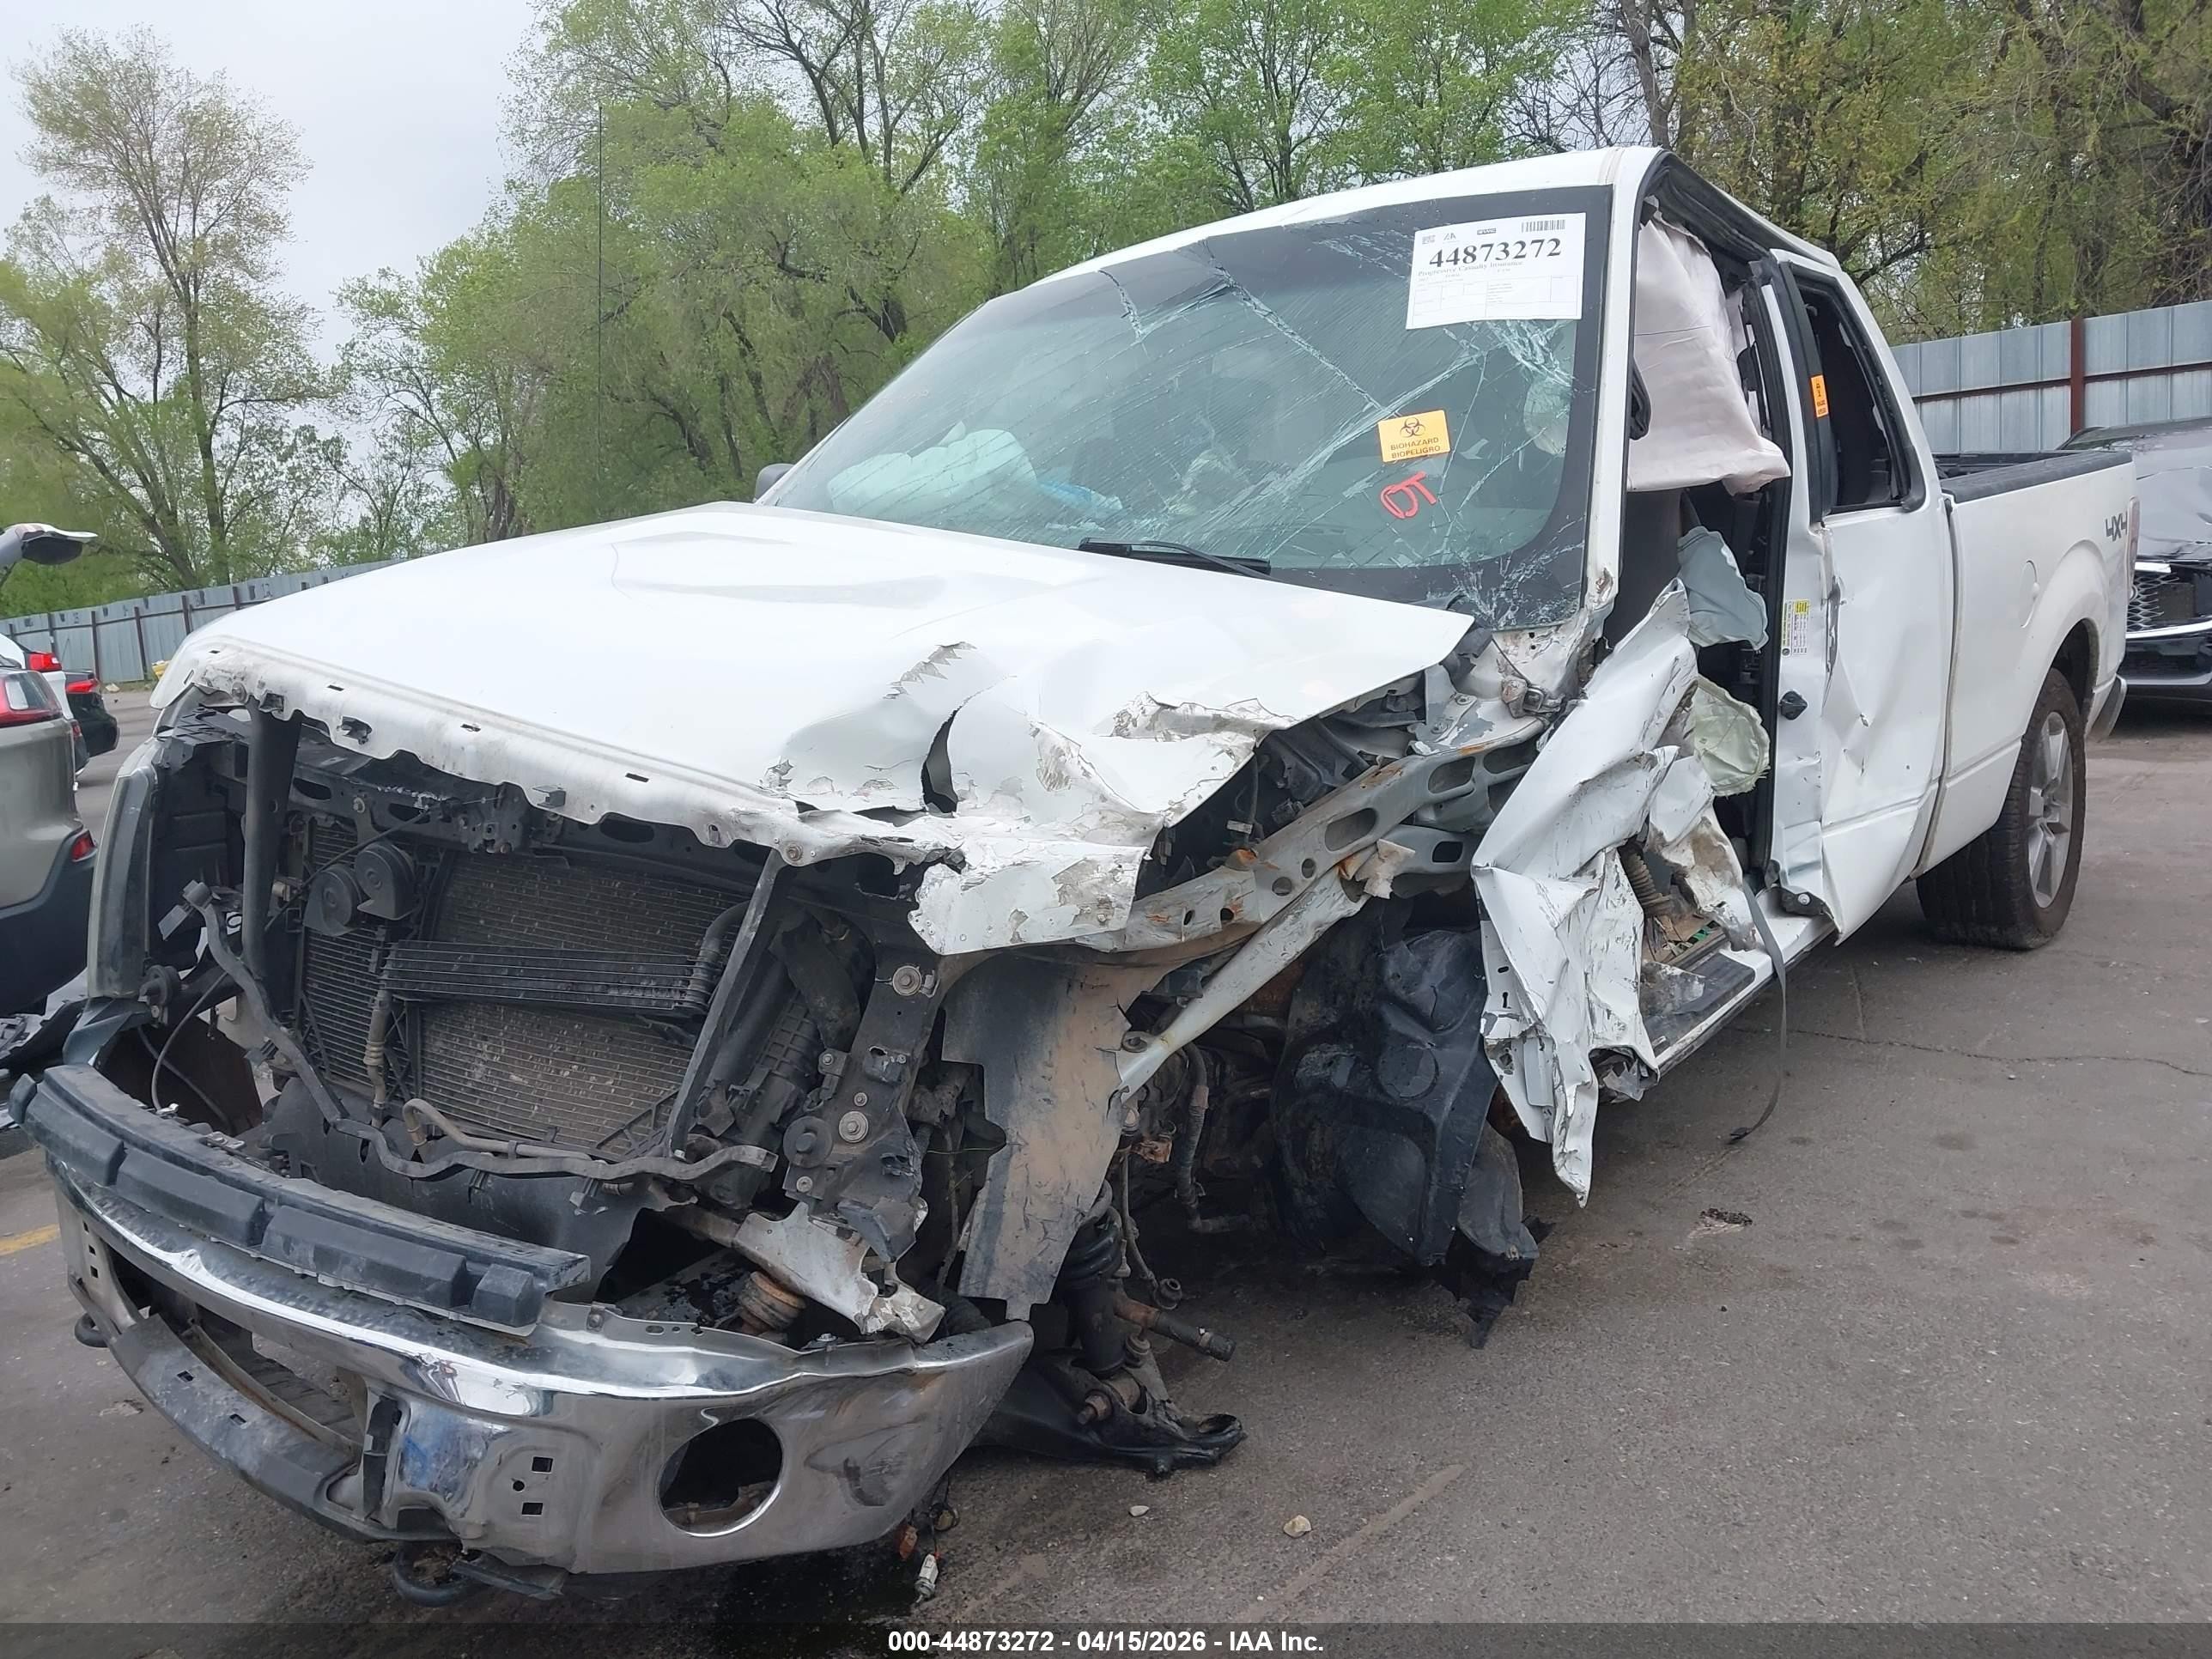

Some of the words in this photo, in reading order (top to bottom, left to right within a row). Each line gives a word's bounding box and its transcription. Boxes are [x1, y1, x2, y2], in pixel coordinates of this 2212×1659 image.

[1429, 238, 1562, 267] 44873272
[1418, 267, 1457, 276] Progressive
[1458, 263, 1487, 272] Casualty
[1390, 437, 1439, 451] BIOHAZARD
[1391, 446, 1441, 459] BIOPELIGRO
